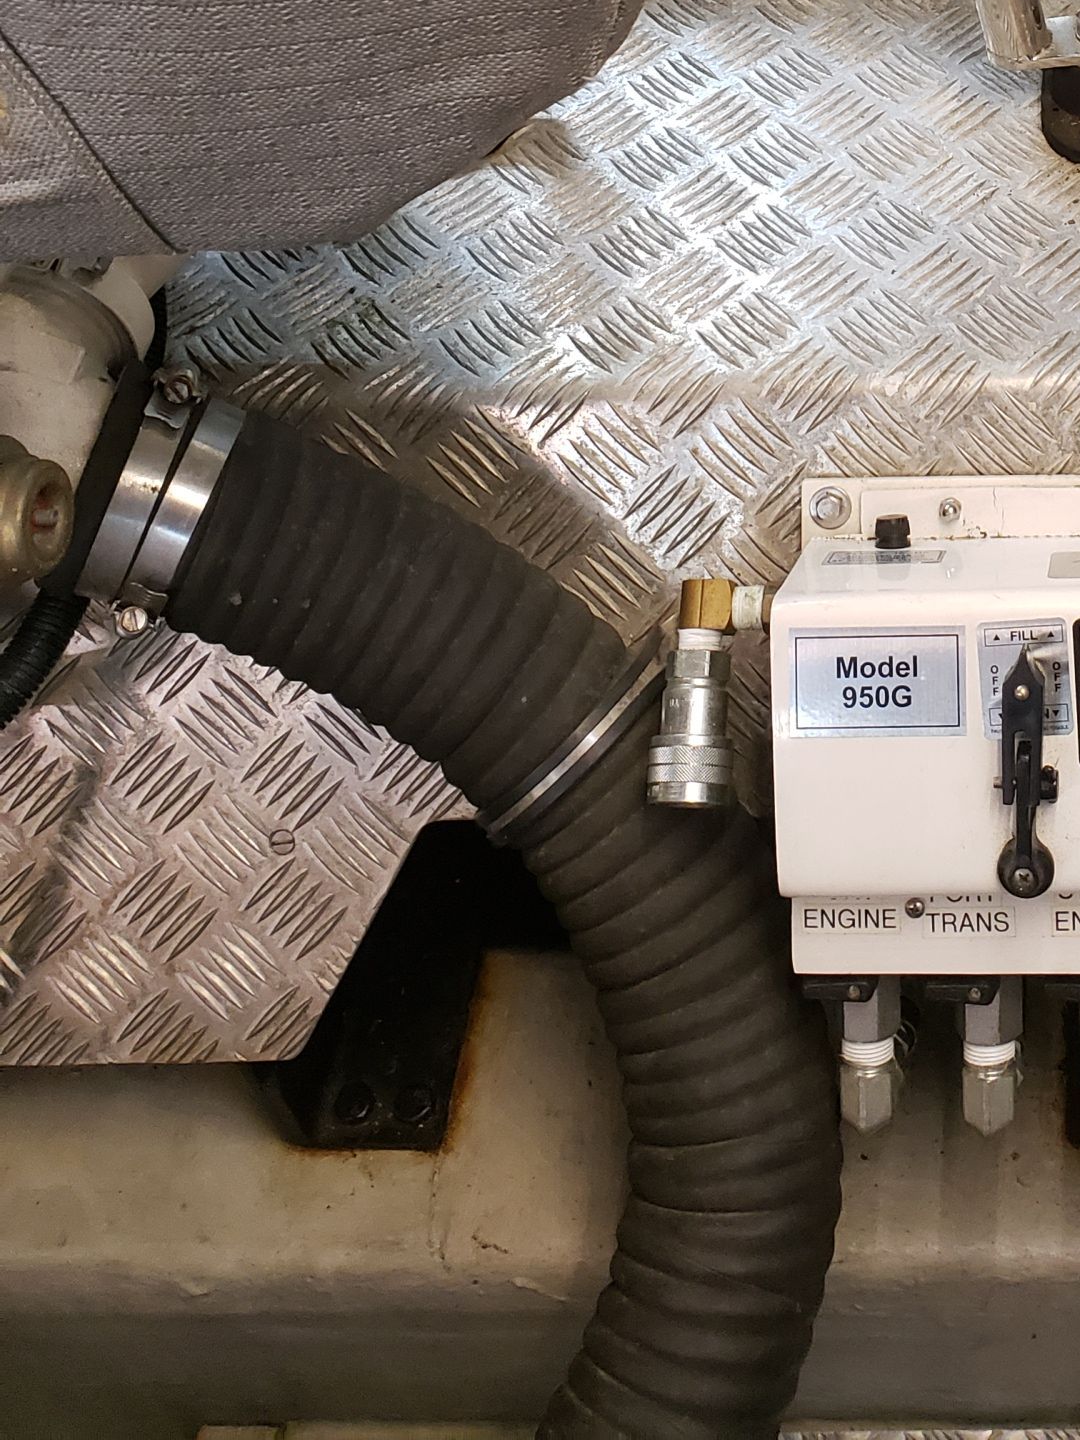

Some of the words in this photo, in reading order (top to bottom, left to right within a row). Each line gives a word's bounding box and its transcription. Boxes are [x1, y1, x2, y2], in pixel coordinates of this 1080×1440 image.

[1010, 629, 1039, 642] FILL
[836, 655, 918, 679] Model
[1052, 661, 1062, 693] OFF
[990, 665, 999, 696] OFF
[842, 685, 912, 709] 950G
[803, 908, 897, 929] ENGINE
[925, 911, 1010, 934] TRANS
